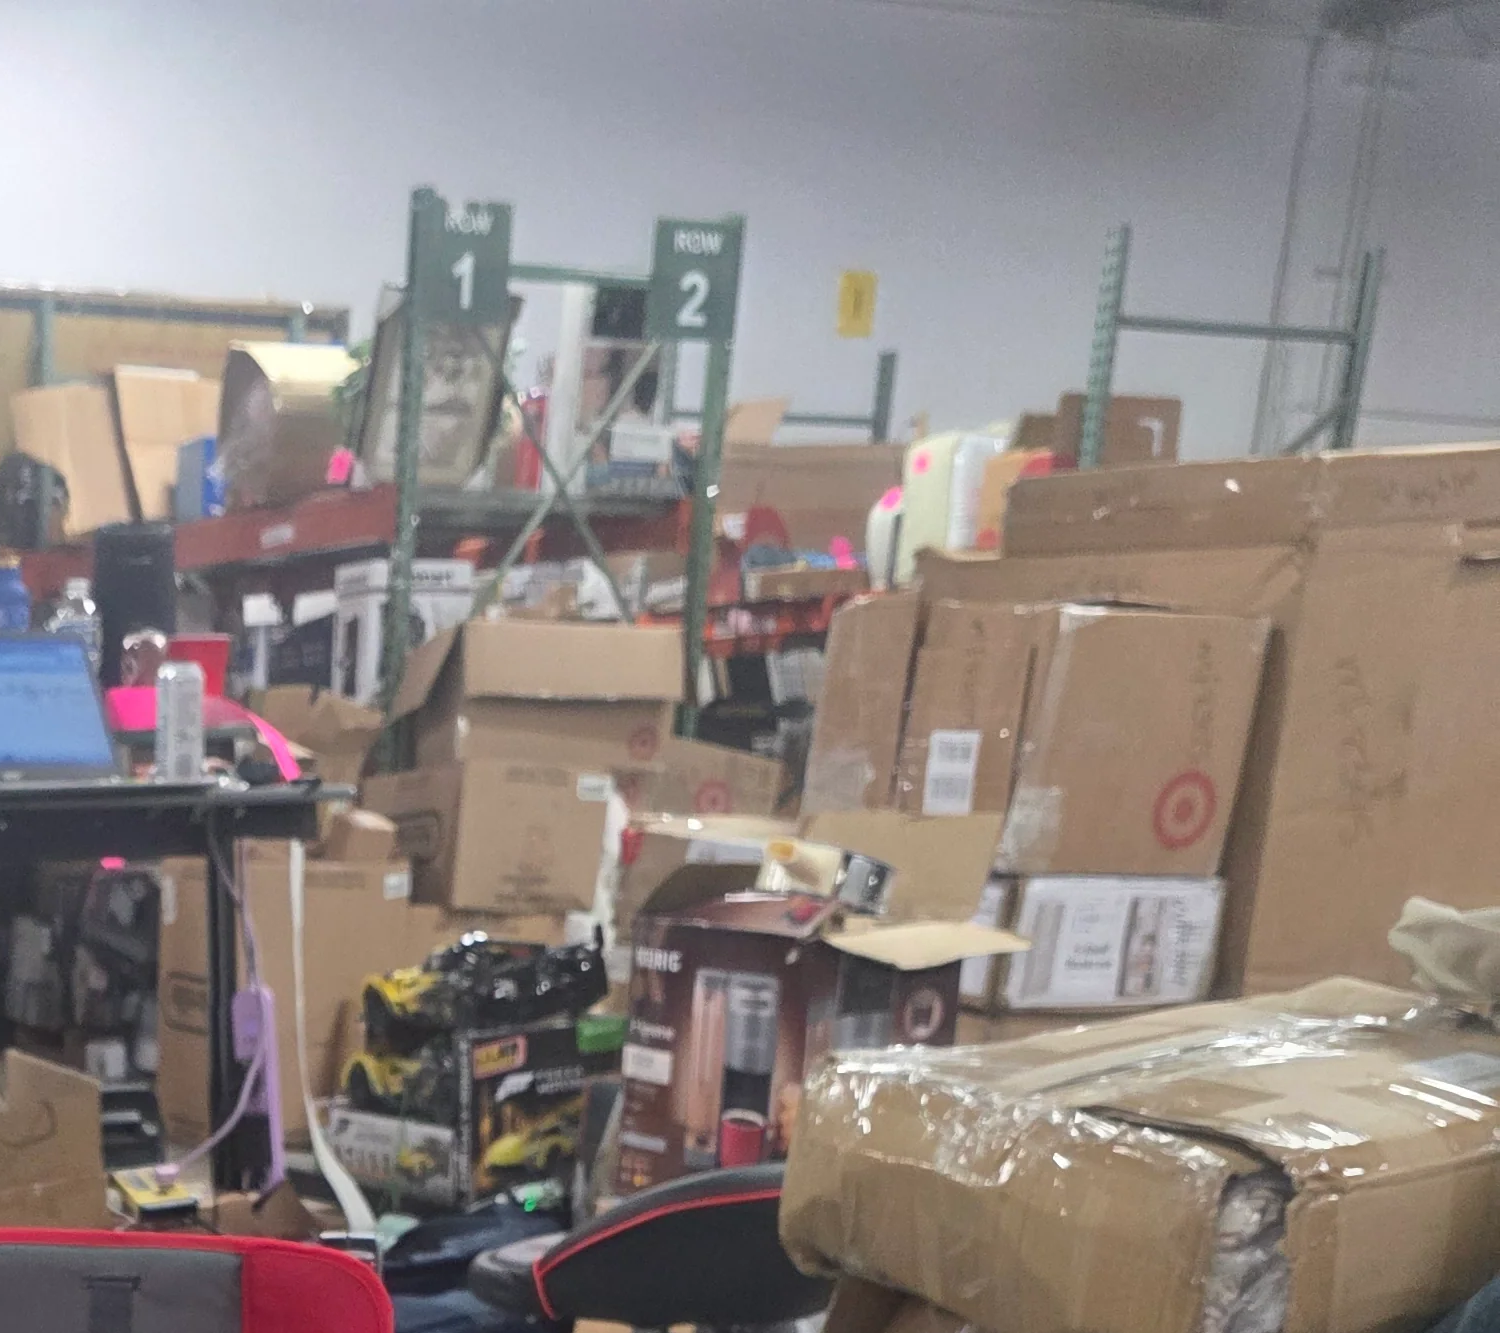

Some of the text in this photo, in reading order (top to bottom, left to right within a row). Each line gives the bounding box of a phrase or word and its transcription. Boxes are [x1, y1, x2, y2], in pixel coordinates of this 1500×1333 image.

[673, 228, 724, 255] ROW
[451, 251, 476, 310] 1
[676, 268, 710, 328] 2
